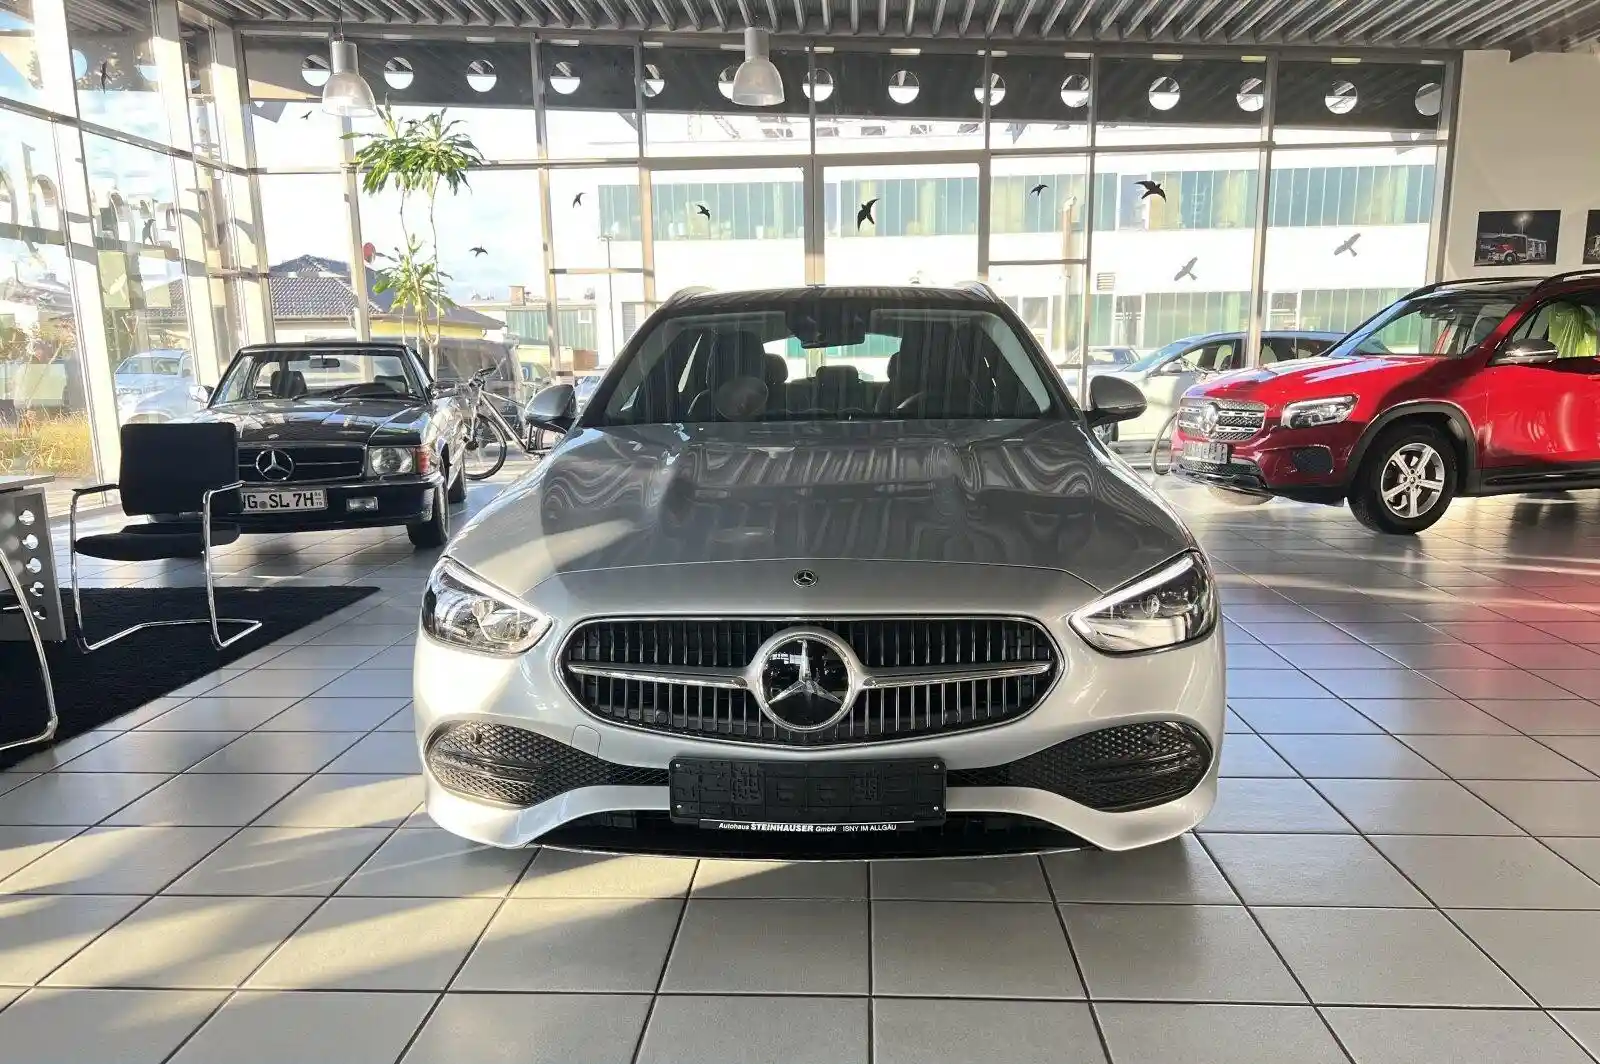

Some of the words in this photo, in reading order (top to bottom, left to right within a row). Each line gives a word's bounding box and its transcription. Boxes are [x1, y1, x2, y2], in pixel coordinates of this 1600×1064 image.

[718, 822, 750, 831] Autohaus
[750, 823, 814, 833] STEINHAUSER
[842, 825, 860, 833] ISNY
